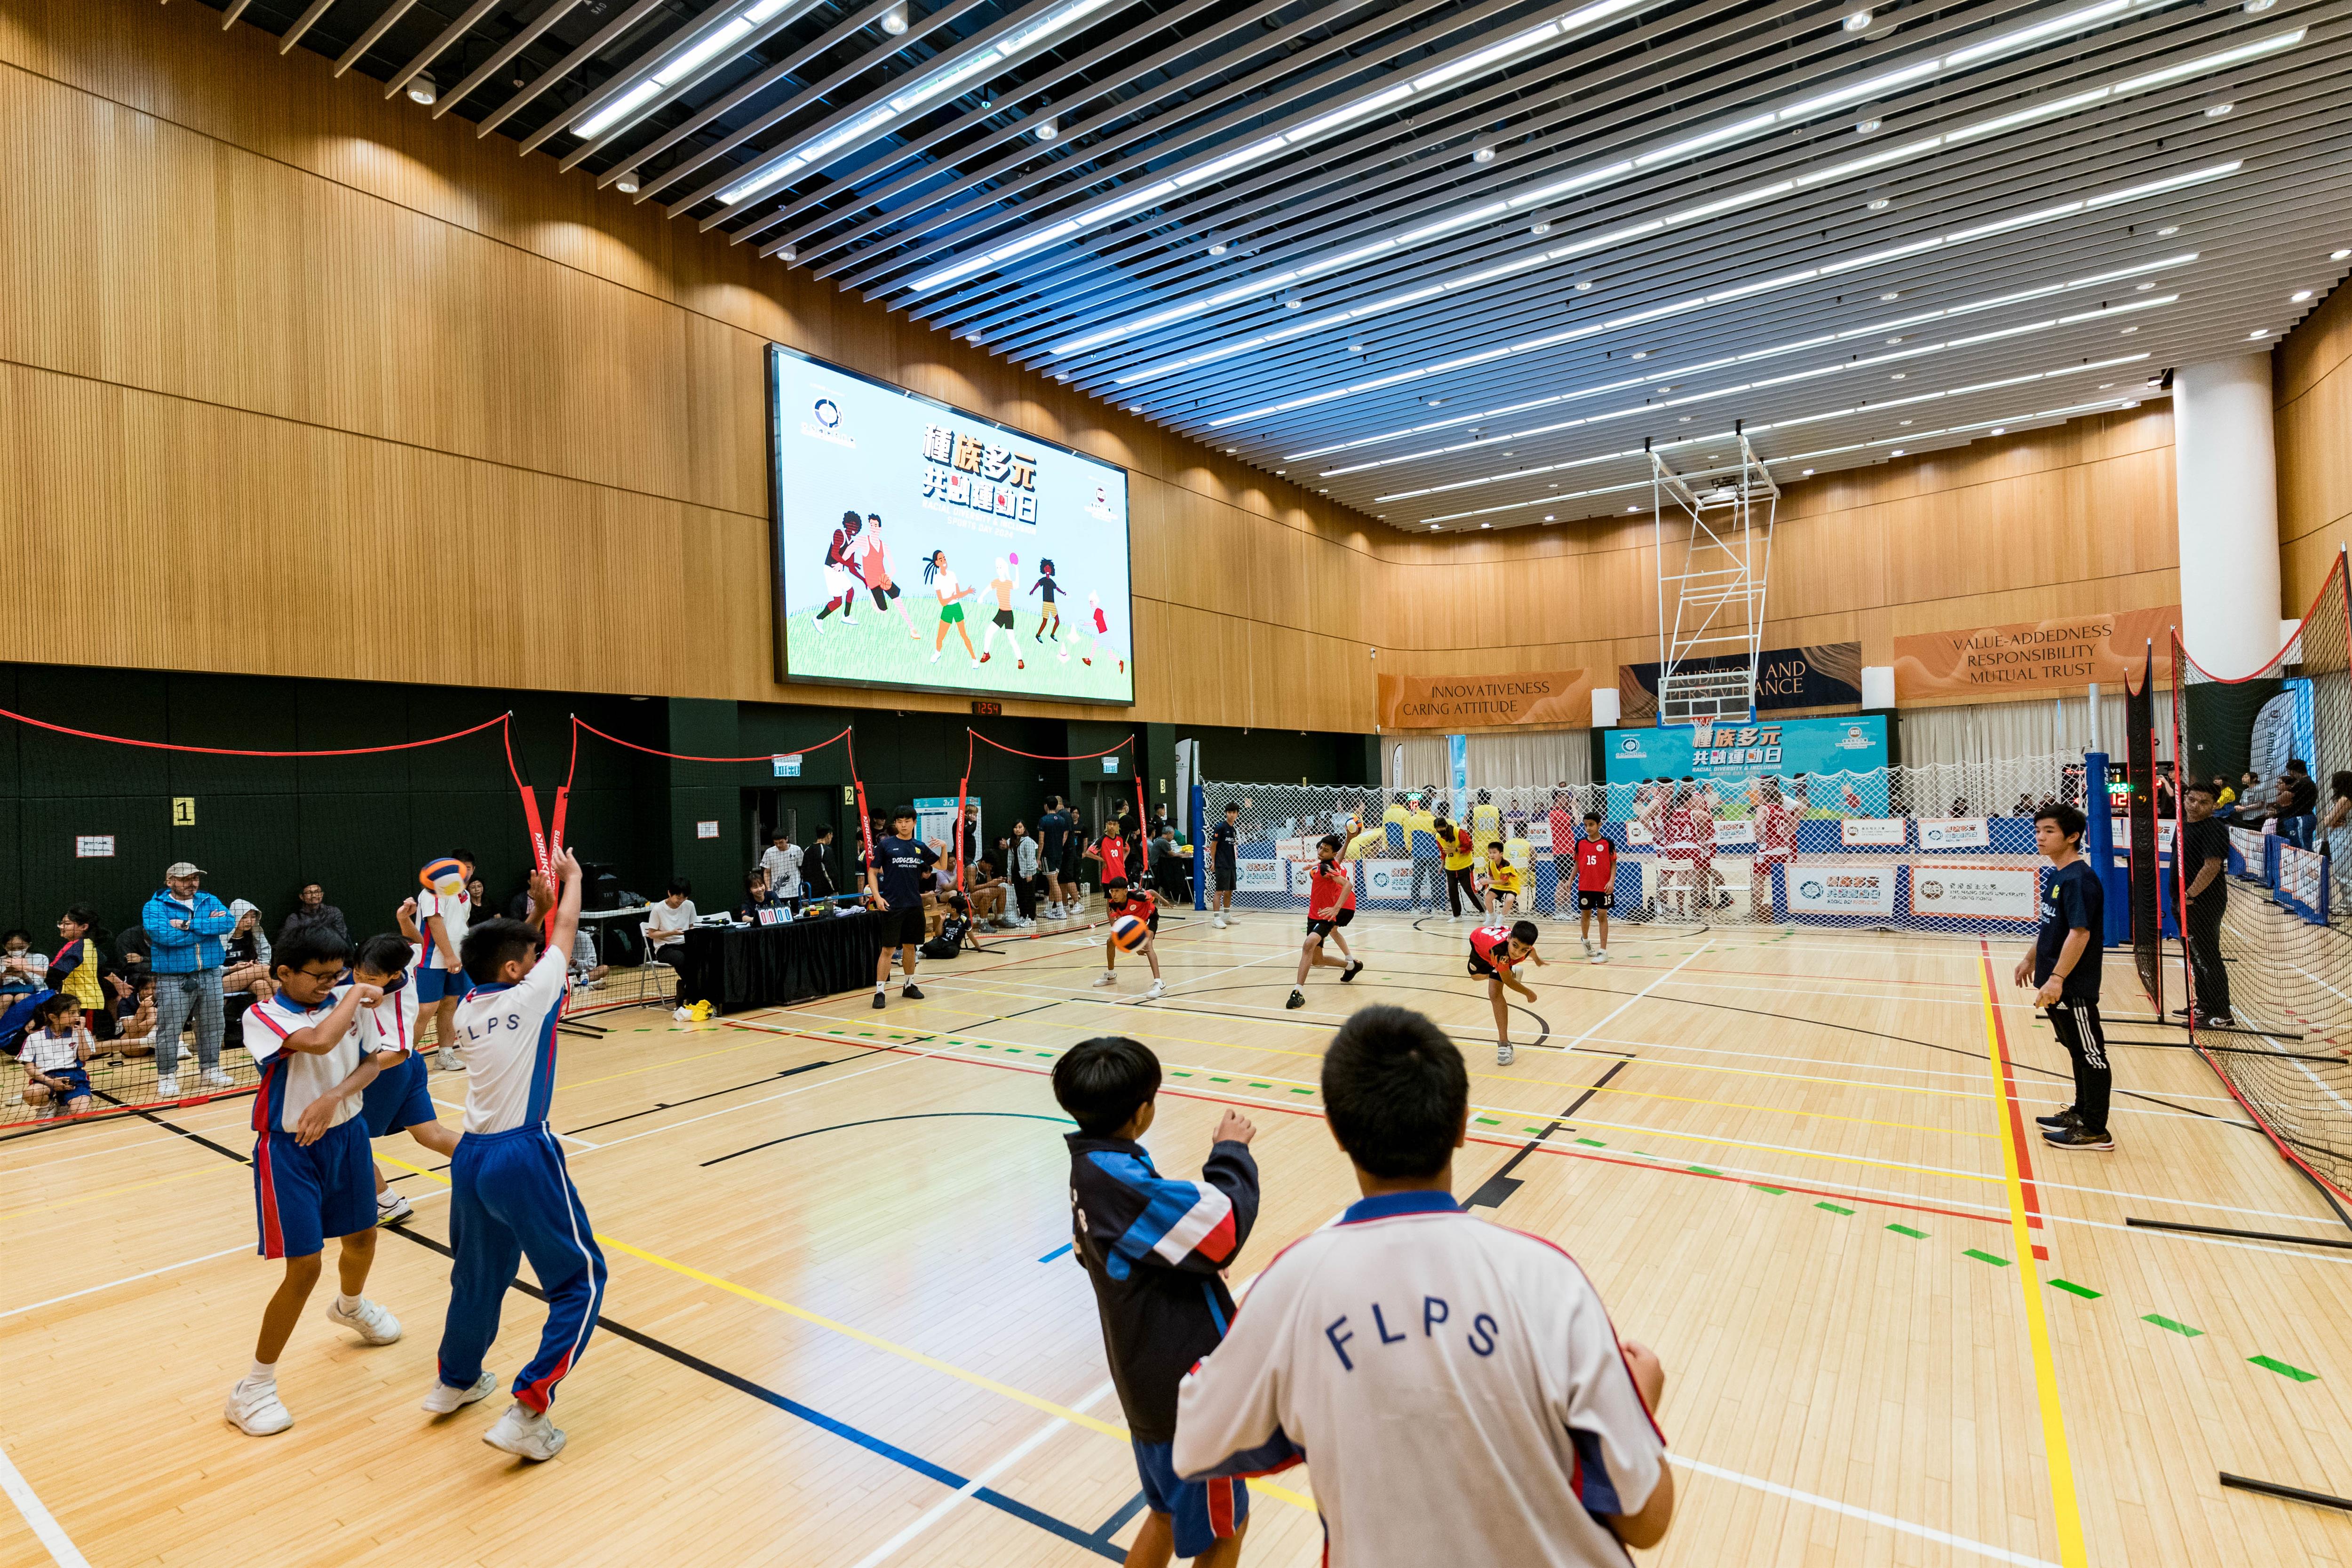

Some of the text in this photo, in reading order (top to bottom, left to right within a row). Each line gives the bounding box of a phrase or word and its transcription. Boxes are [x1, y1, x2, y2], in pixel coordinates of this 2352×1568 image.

[922, 423, 1037, 492] 種族多元
[922, 466, 1037, 525] 共融運動日
[922, 499, 951, 515] RACIAL
[953, 507, 992, 524] DIVERSITY
[1000, 520, 1037, 535] INCLUSION
[947, 516, 976, 531] SPORTS
[978, 524, 993, 534] DAY
[1954, 624, 2112, 651] VALUE-ADDEDNESS
[1968, 644, 2096, 667] RESPONSIBILITY
[1766, 661, 1806, 679] AND
[1971, 662, 2095, 684] MUTUAL TRUST
[1432, 681, 1550, 698] INNOVATIVENESS
[1403, 700, 1518, 716] CARING ATTITUDE
[1692, 726, 1782, 748] 種族多元
[1692, 747, 1782, 766] 共融運動日
[2265, 732, 2276, 775] Ambition
[775, 765, 799, 775] EXIT 出口
[846, 789, 853, 802] 2
[1161, 781, 1165, 791] 3
[177, 802, 191, 821] 1
[1111, 849, 1118, 858] 20
[1587, 855, 1597, 866] 15
[1604, 895, 1611, 906] 15
[1325, 1295, 1499, 1373] FLPS
